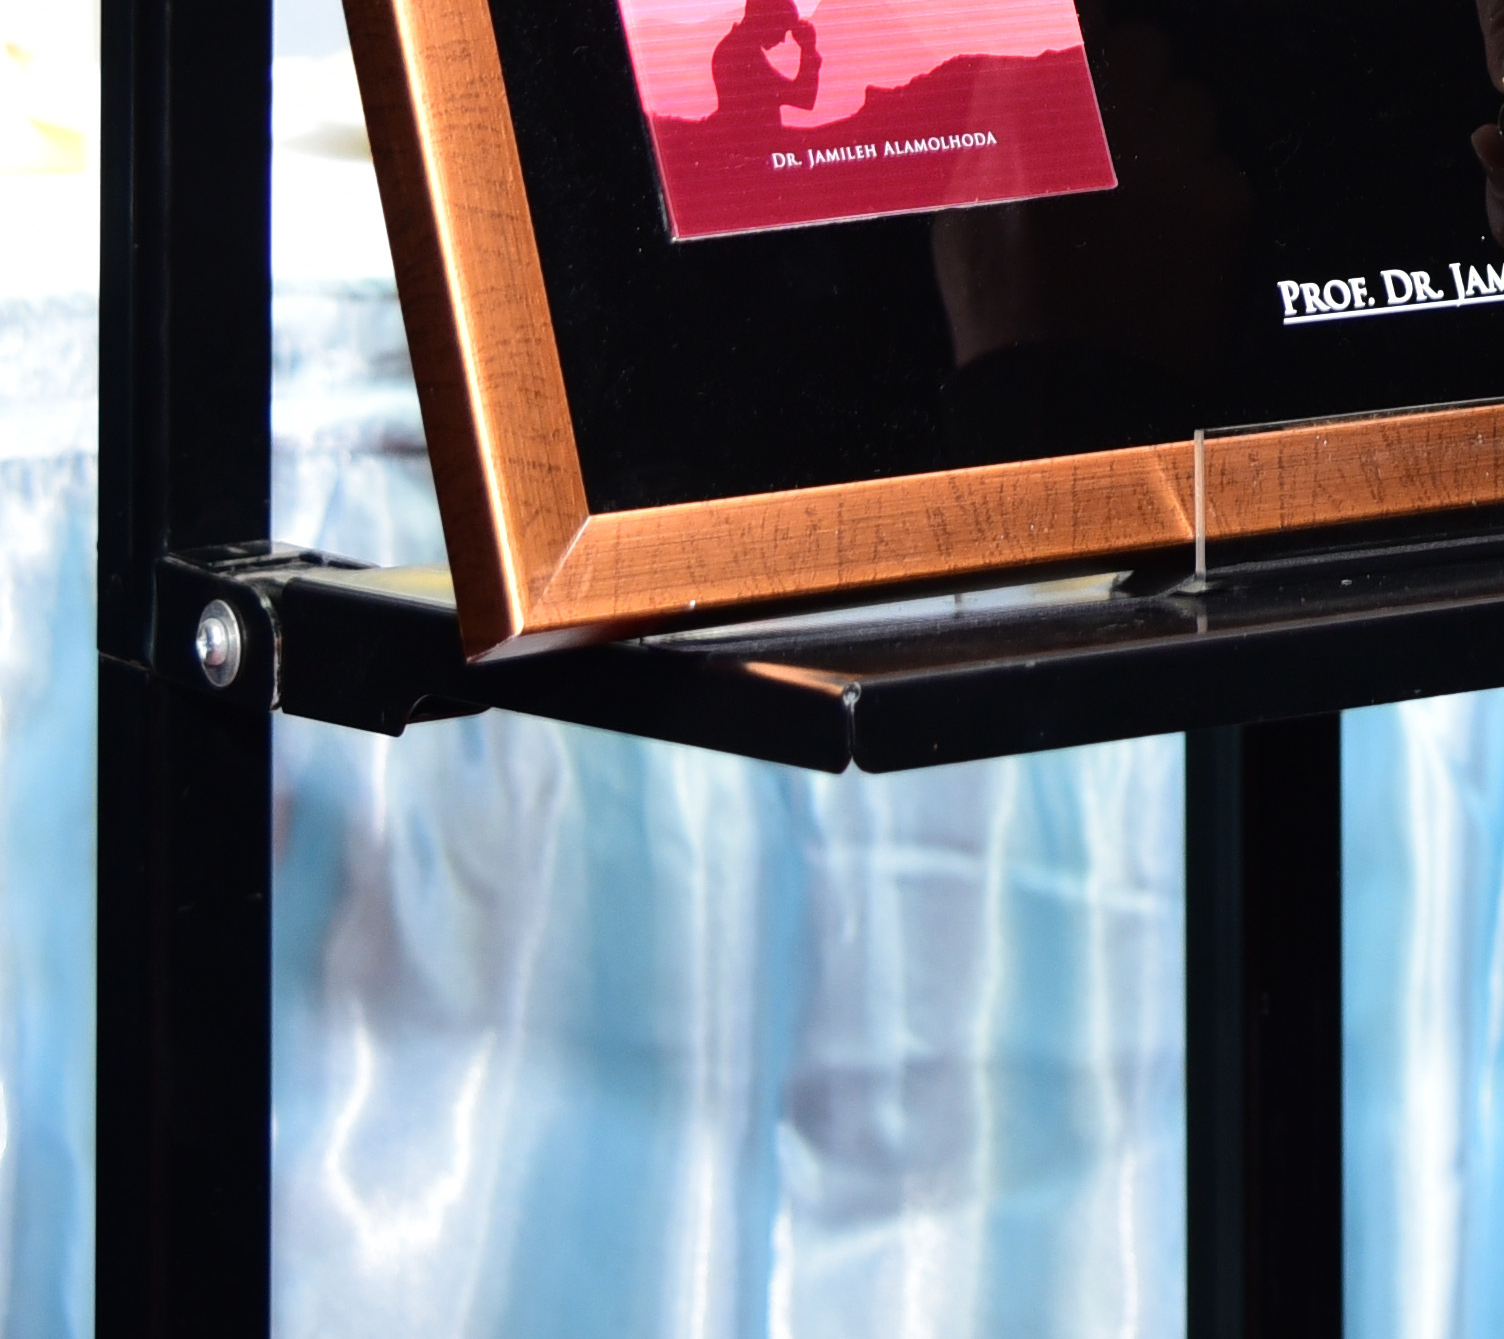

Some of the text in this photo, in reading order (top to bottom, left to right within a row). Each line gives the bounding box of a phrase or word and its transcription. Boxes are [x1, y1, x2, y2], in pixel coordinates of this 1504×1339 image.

[772, 131, 998, 169] DR. JAMILEH ALAMOLHODA
[1277, 276, 1375, 316] PROF.
[1380, 269, 1444, 305] DR.
